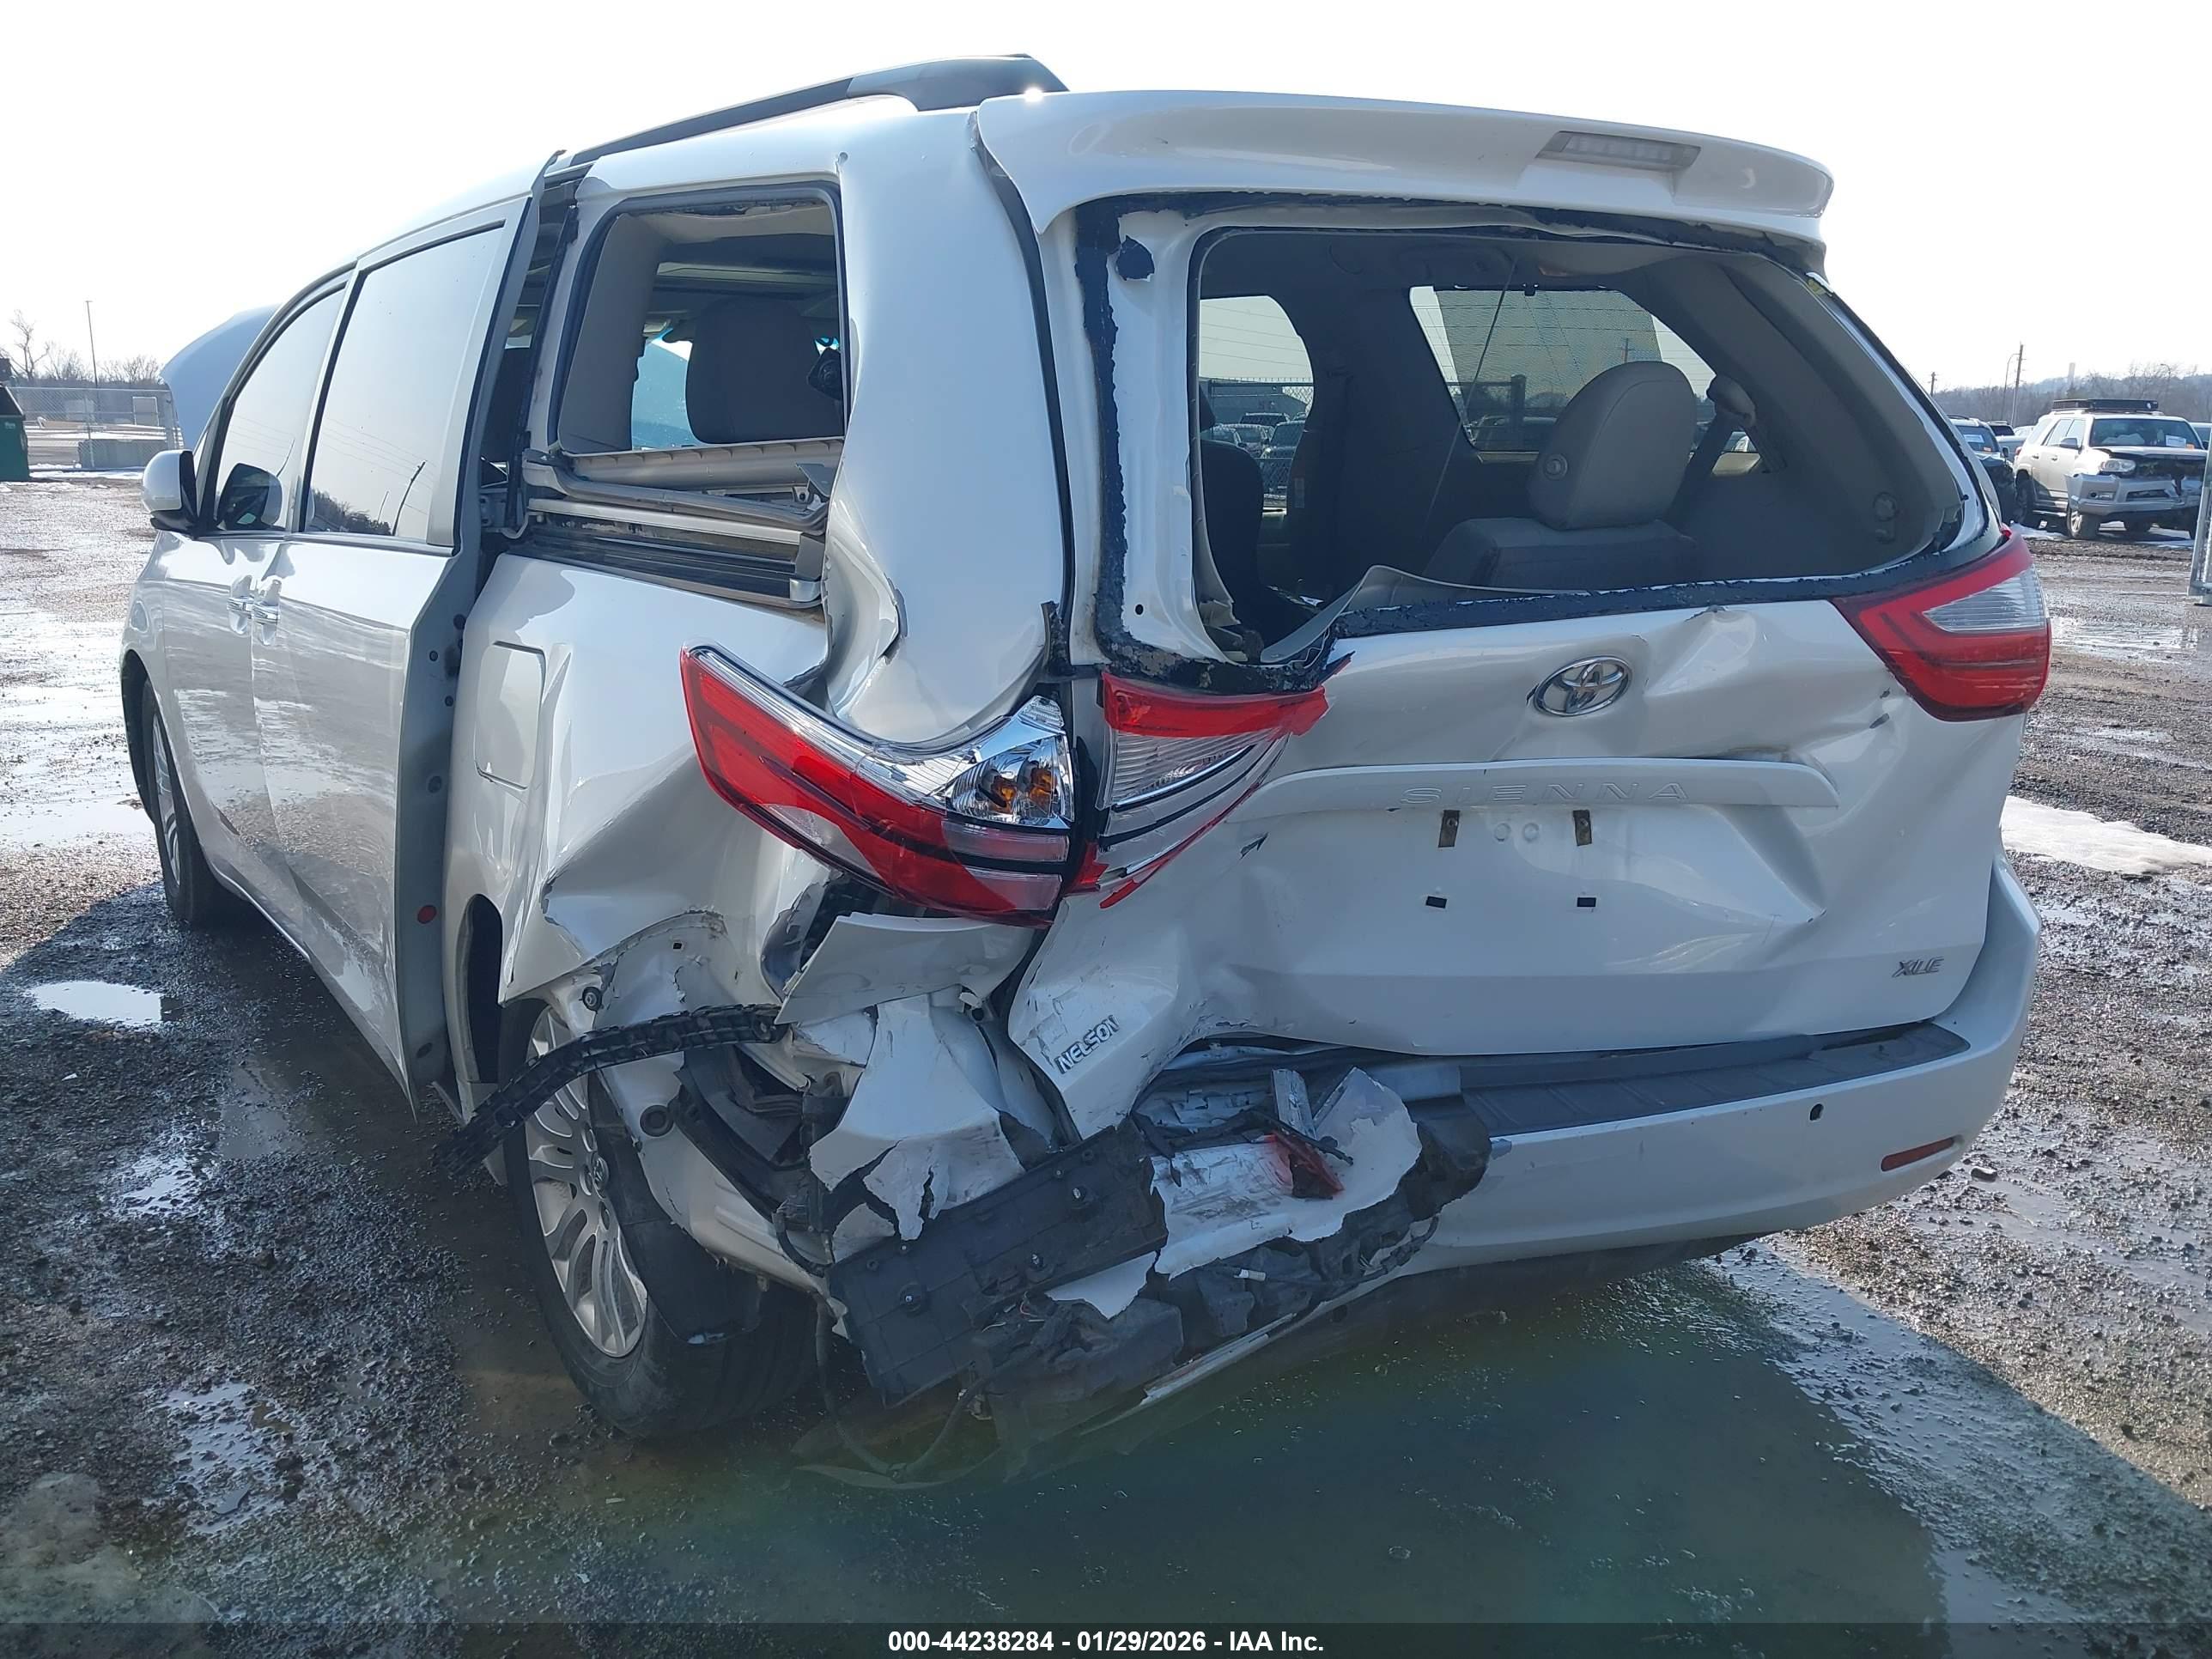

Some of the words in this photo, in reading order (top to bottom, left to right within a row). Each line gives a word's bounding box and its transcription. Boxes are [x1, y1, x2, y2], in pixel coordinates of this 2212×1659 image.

[1401, 782, 1688, 804] SIENNA
[1892, 956, 1944, 977] XLE
[1054, 1015, 1119, 1073] NELSON
